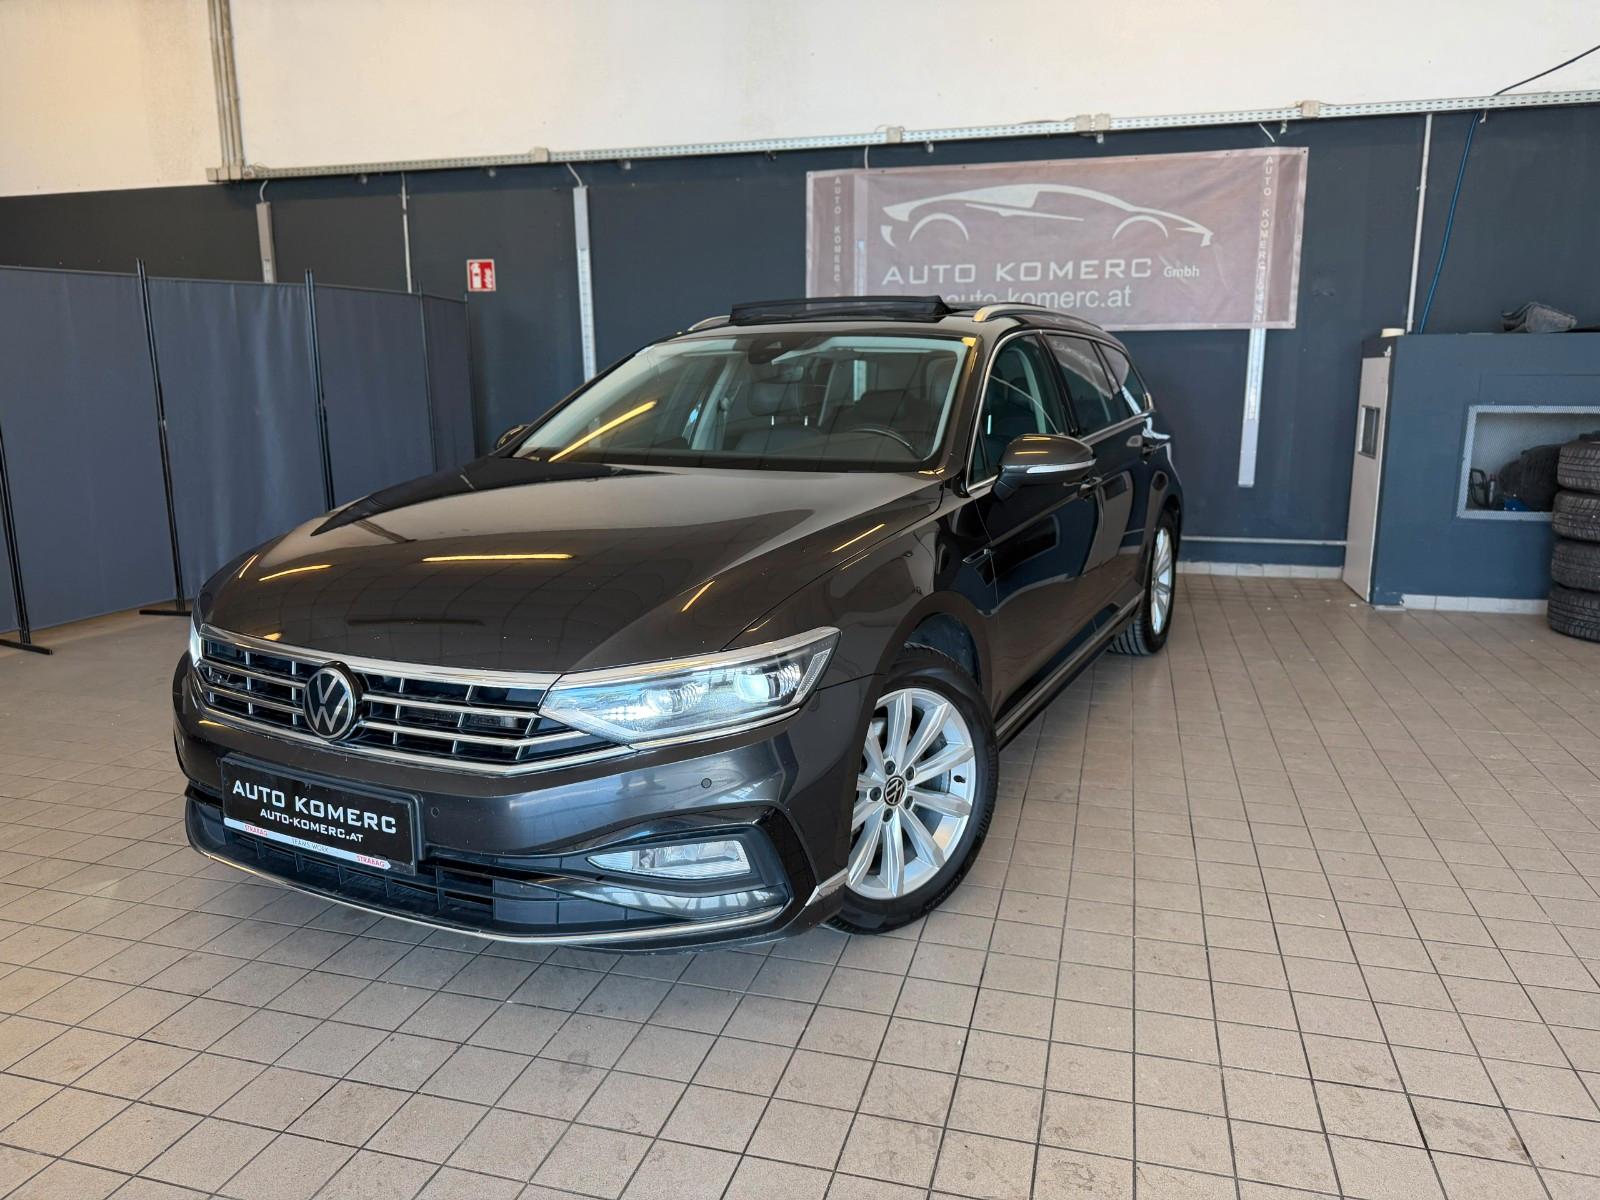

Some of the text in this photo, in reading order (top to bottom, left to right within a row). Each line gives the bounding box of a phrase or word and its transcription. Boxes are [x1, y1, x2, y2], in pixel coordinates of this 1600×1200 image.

[1263, 155, 1273, 196] AUTO
[833, 176, 841, 215] AUTO
[881, 258, 1200, 286] AUTO KOMERC Gmbh
[232, 780, 397, 834] AUTO KOMERC
[357, 855, 385, 868] STRABAG
